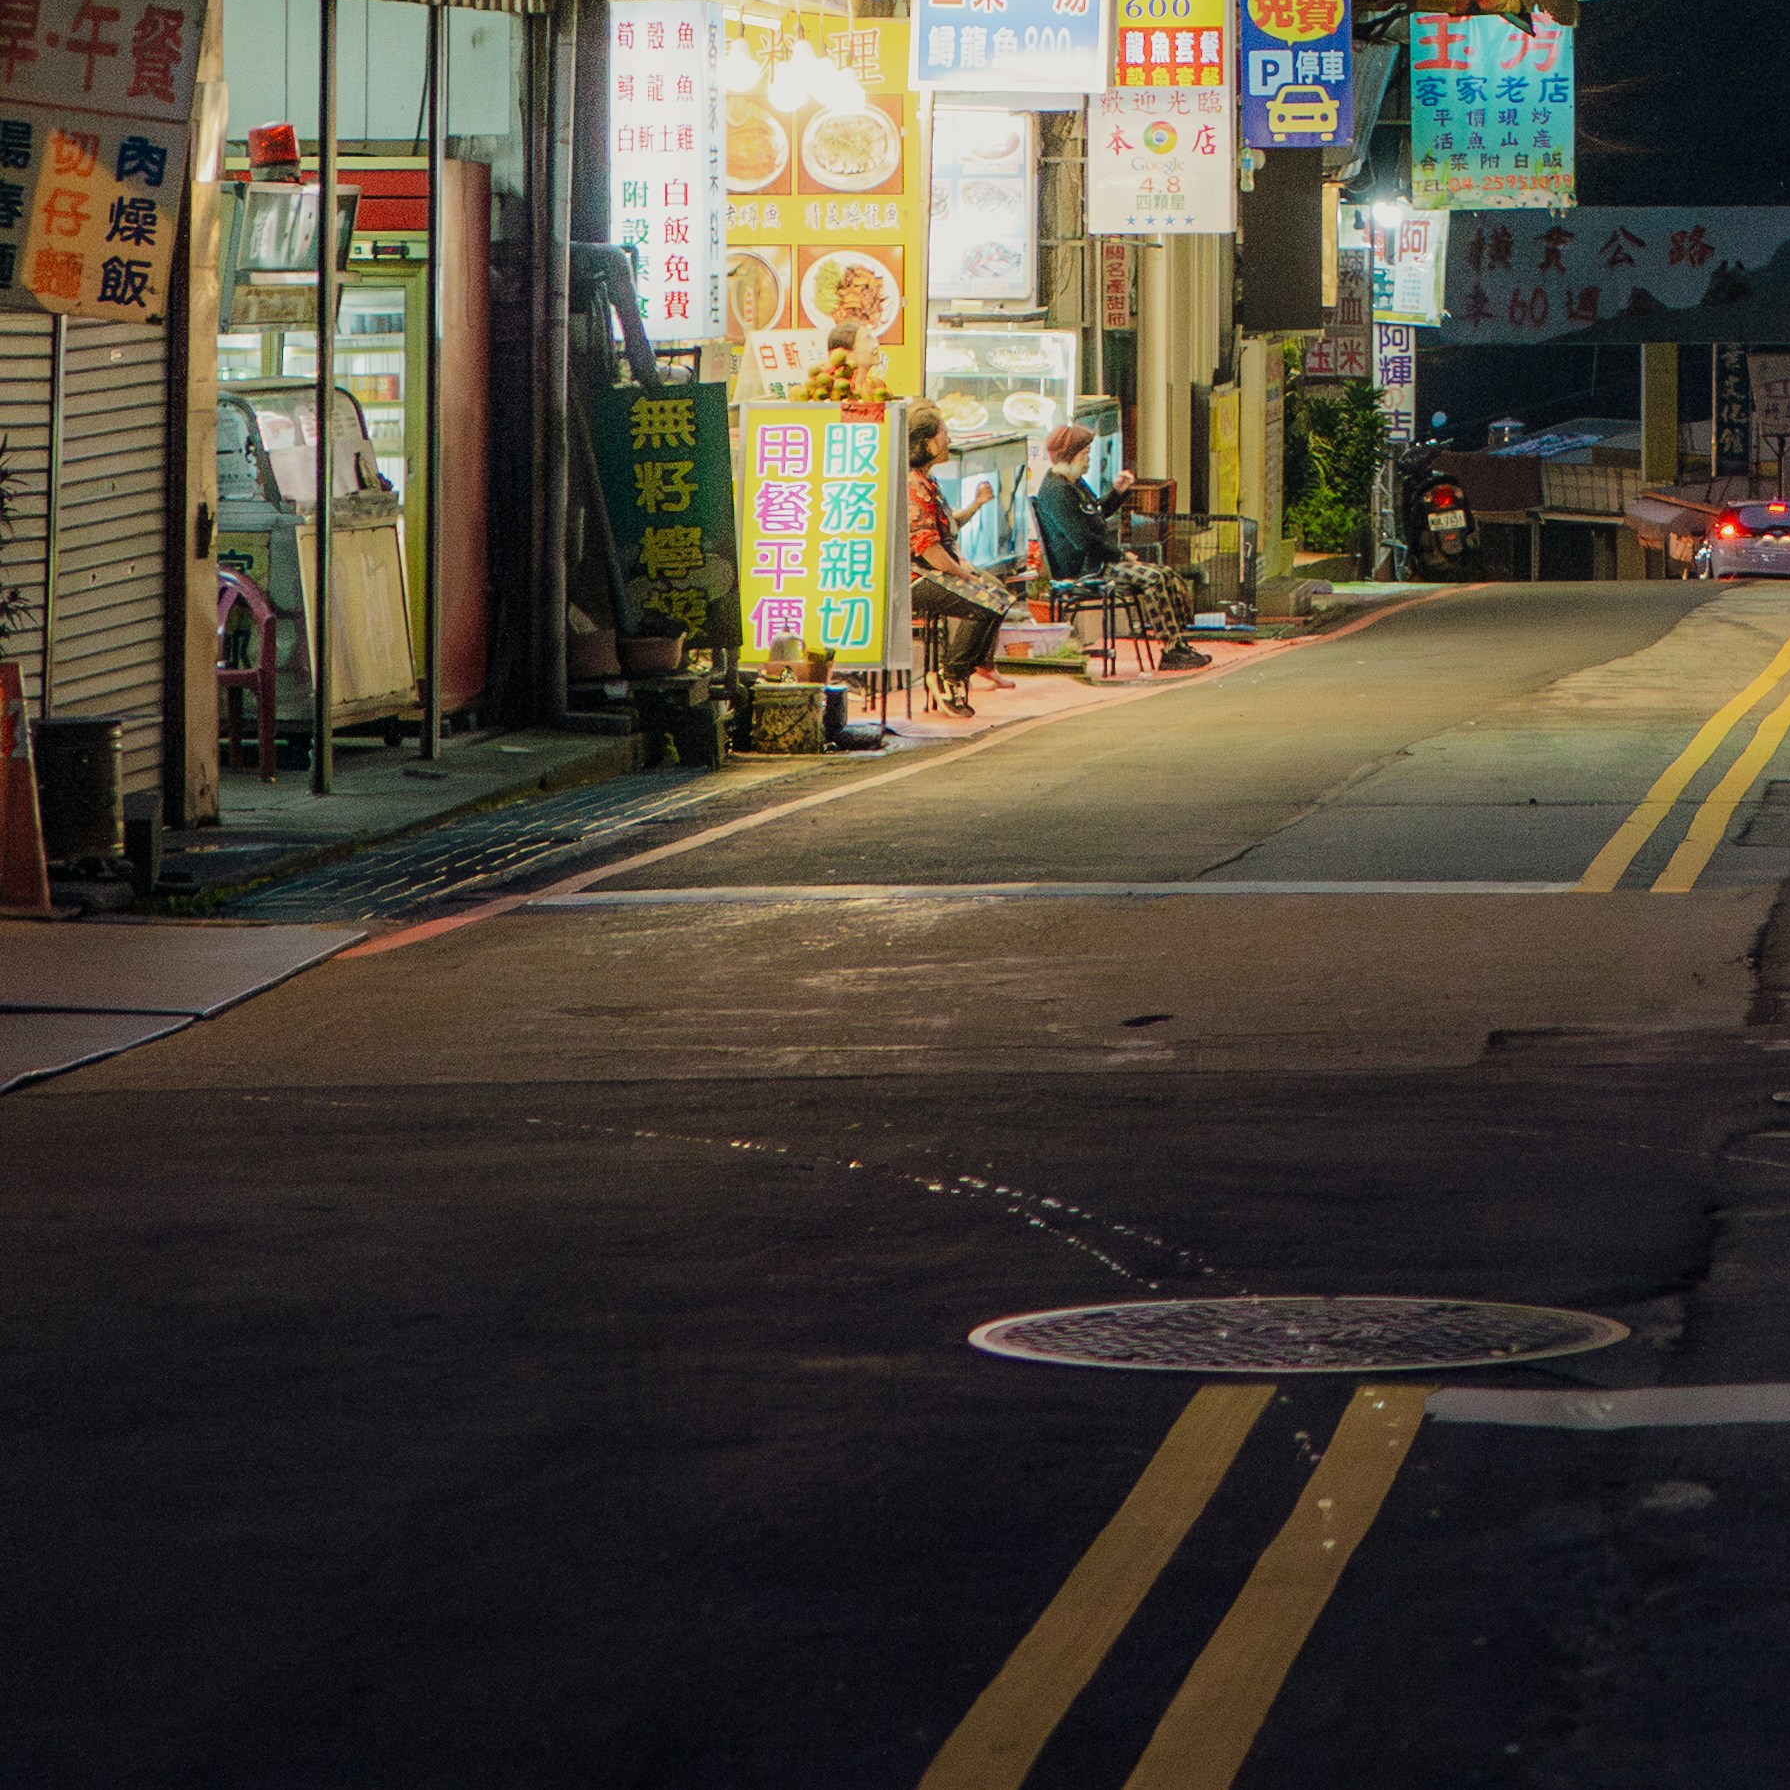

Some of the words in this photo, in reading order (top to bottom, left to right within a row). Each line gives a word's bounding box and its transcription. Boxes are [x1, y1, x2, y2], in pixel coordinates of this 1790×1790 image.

[616, 21, 695, 51] 筍殼魚
[1295, 49, 1345, 85] 停車
[1101, 90, 1223, 117] 歡迎光臨
[1415, 72, 1570, 107] 客家老店
[617, 124, 695, 155] 白斬土雞
[1131, 156, 1185, 175] Google
[1139, 176, 1182, 194] 4.8
[1136, 194, 1186, 211] 四顆星
[97, 136, 168, 308] 肉燥飯
[663, 177, 690, 321] 白飯免費
[749, 423, 814, 651] 用餐平價
[816, 423, 880, 650] 服務親切
